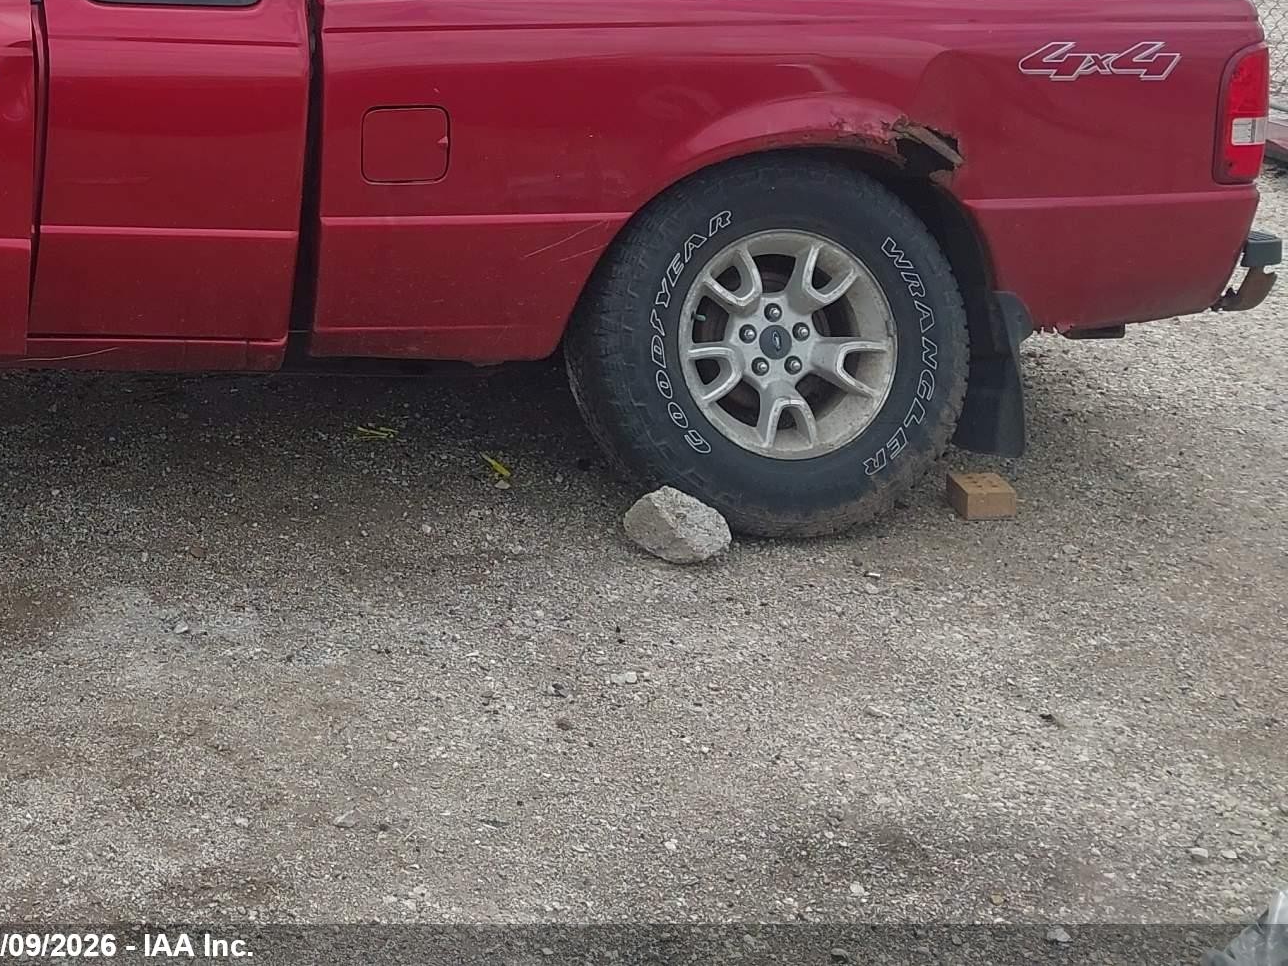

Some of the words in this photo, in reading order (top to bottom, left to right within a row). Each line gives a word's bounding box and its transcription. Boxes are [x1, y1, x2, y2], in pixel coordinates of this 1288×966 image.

[1018, 41, 1183, 81] 4x4
[650, 210, 732, 454] GOODYEAR
[863, 236, 939, 477] WRANGLER
